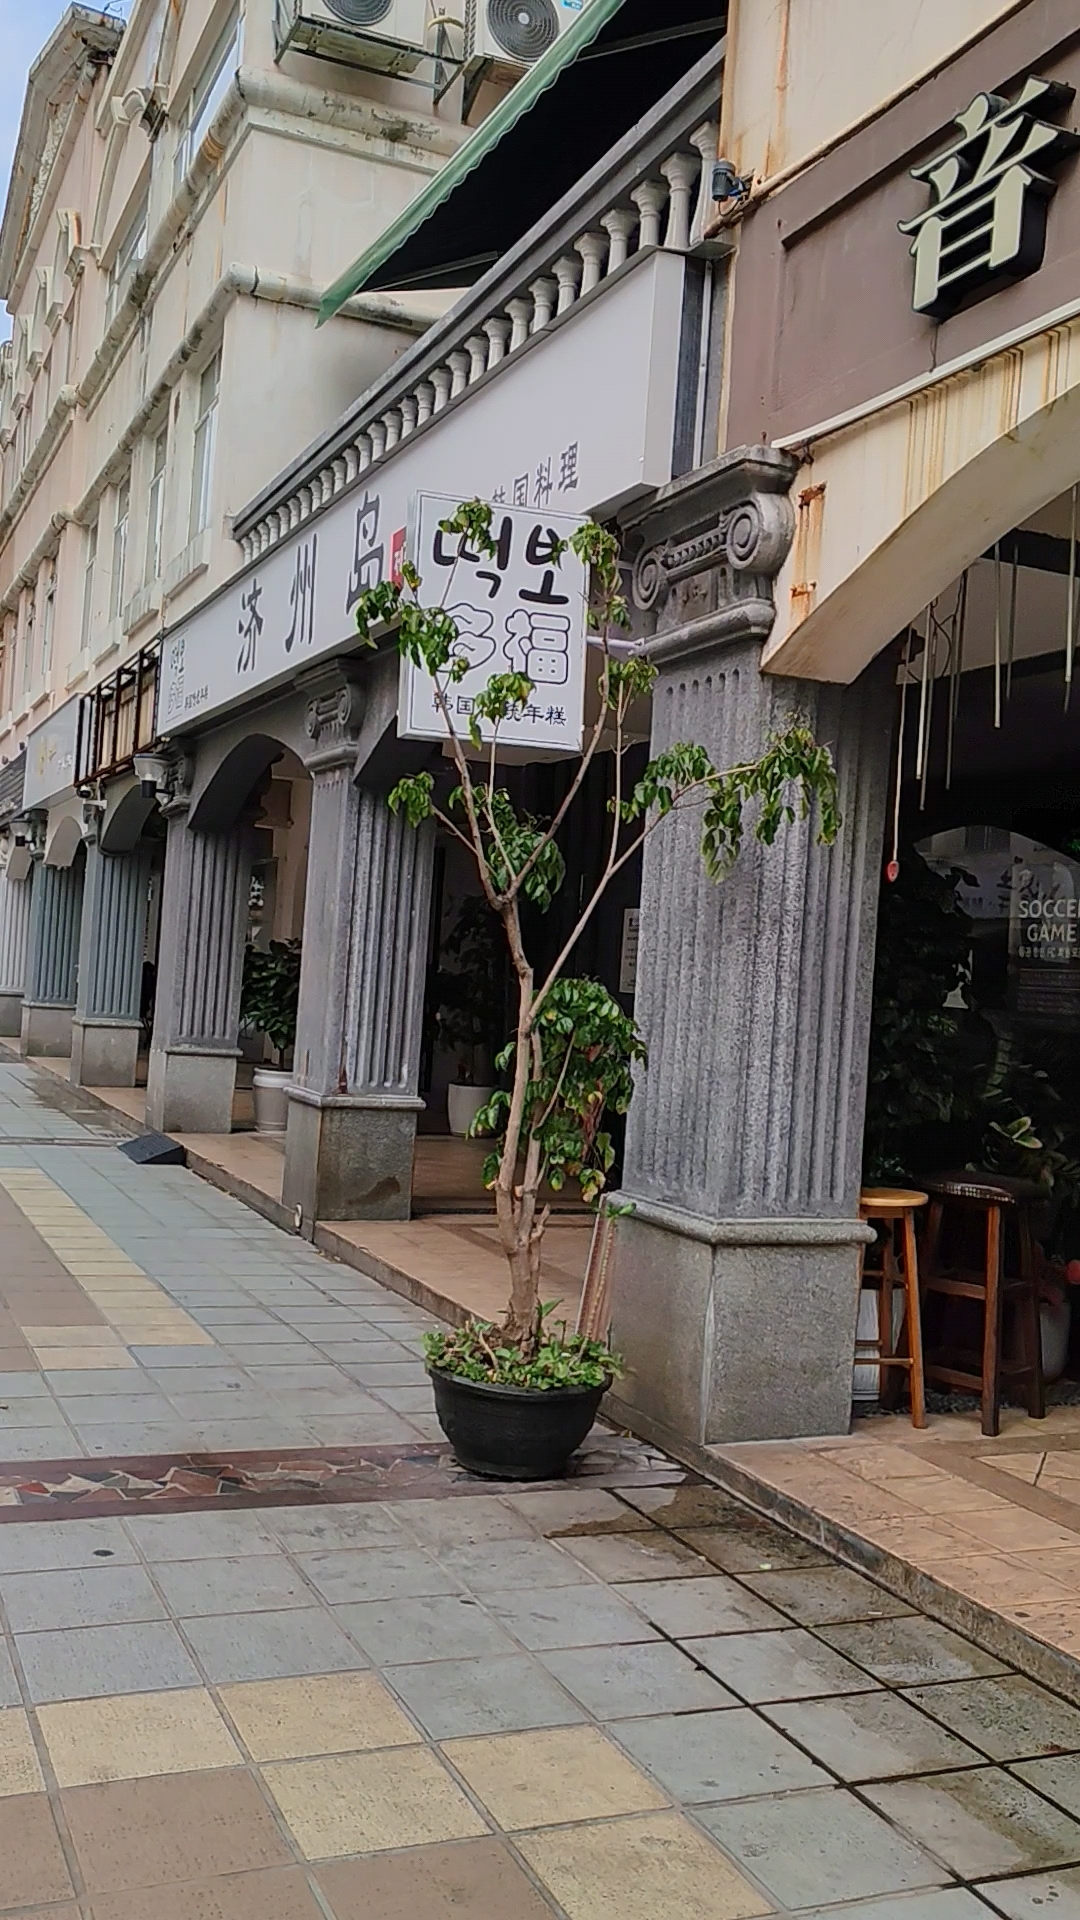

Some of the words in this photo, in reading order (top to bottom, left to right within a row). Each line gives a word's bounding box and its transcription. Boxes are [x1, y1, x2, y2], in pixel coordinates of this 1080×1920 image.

[897, 75, 1062, 313] 音
[237, 490, 385, 675] 济州岛
[430, 692, 568, 727] 韩国统年糕
[1018, 899, 1080, 919] SOCCE
[1027, 924, 1077, 942] GAME
